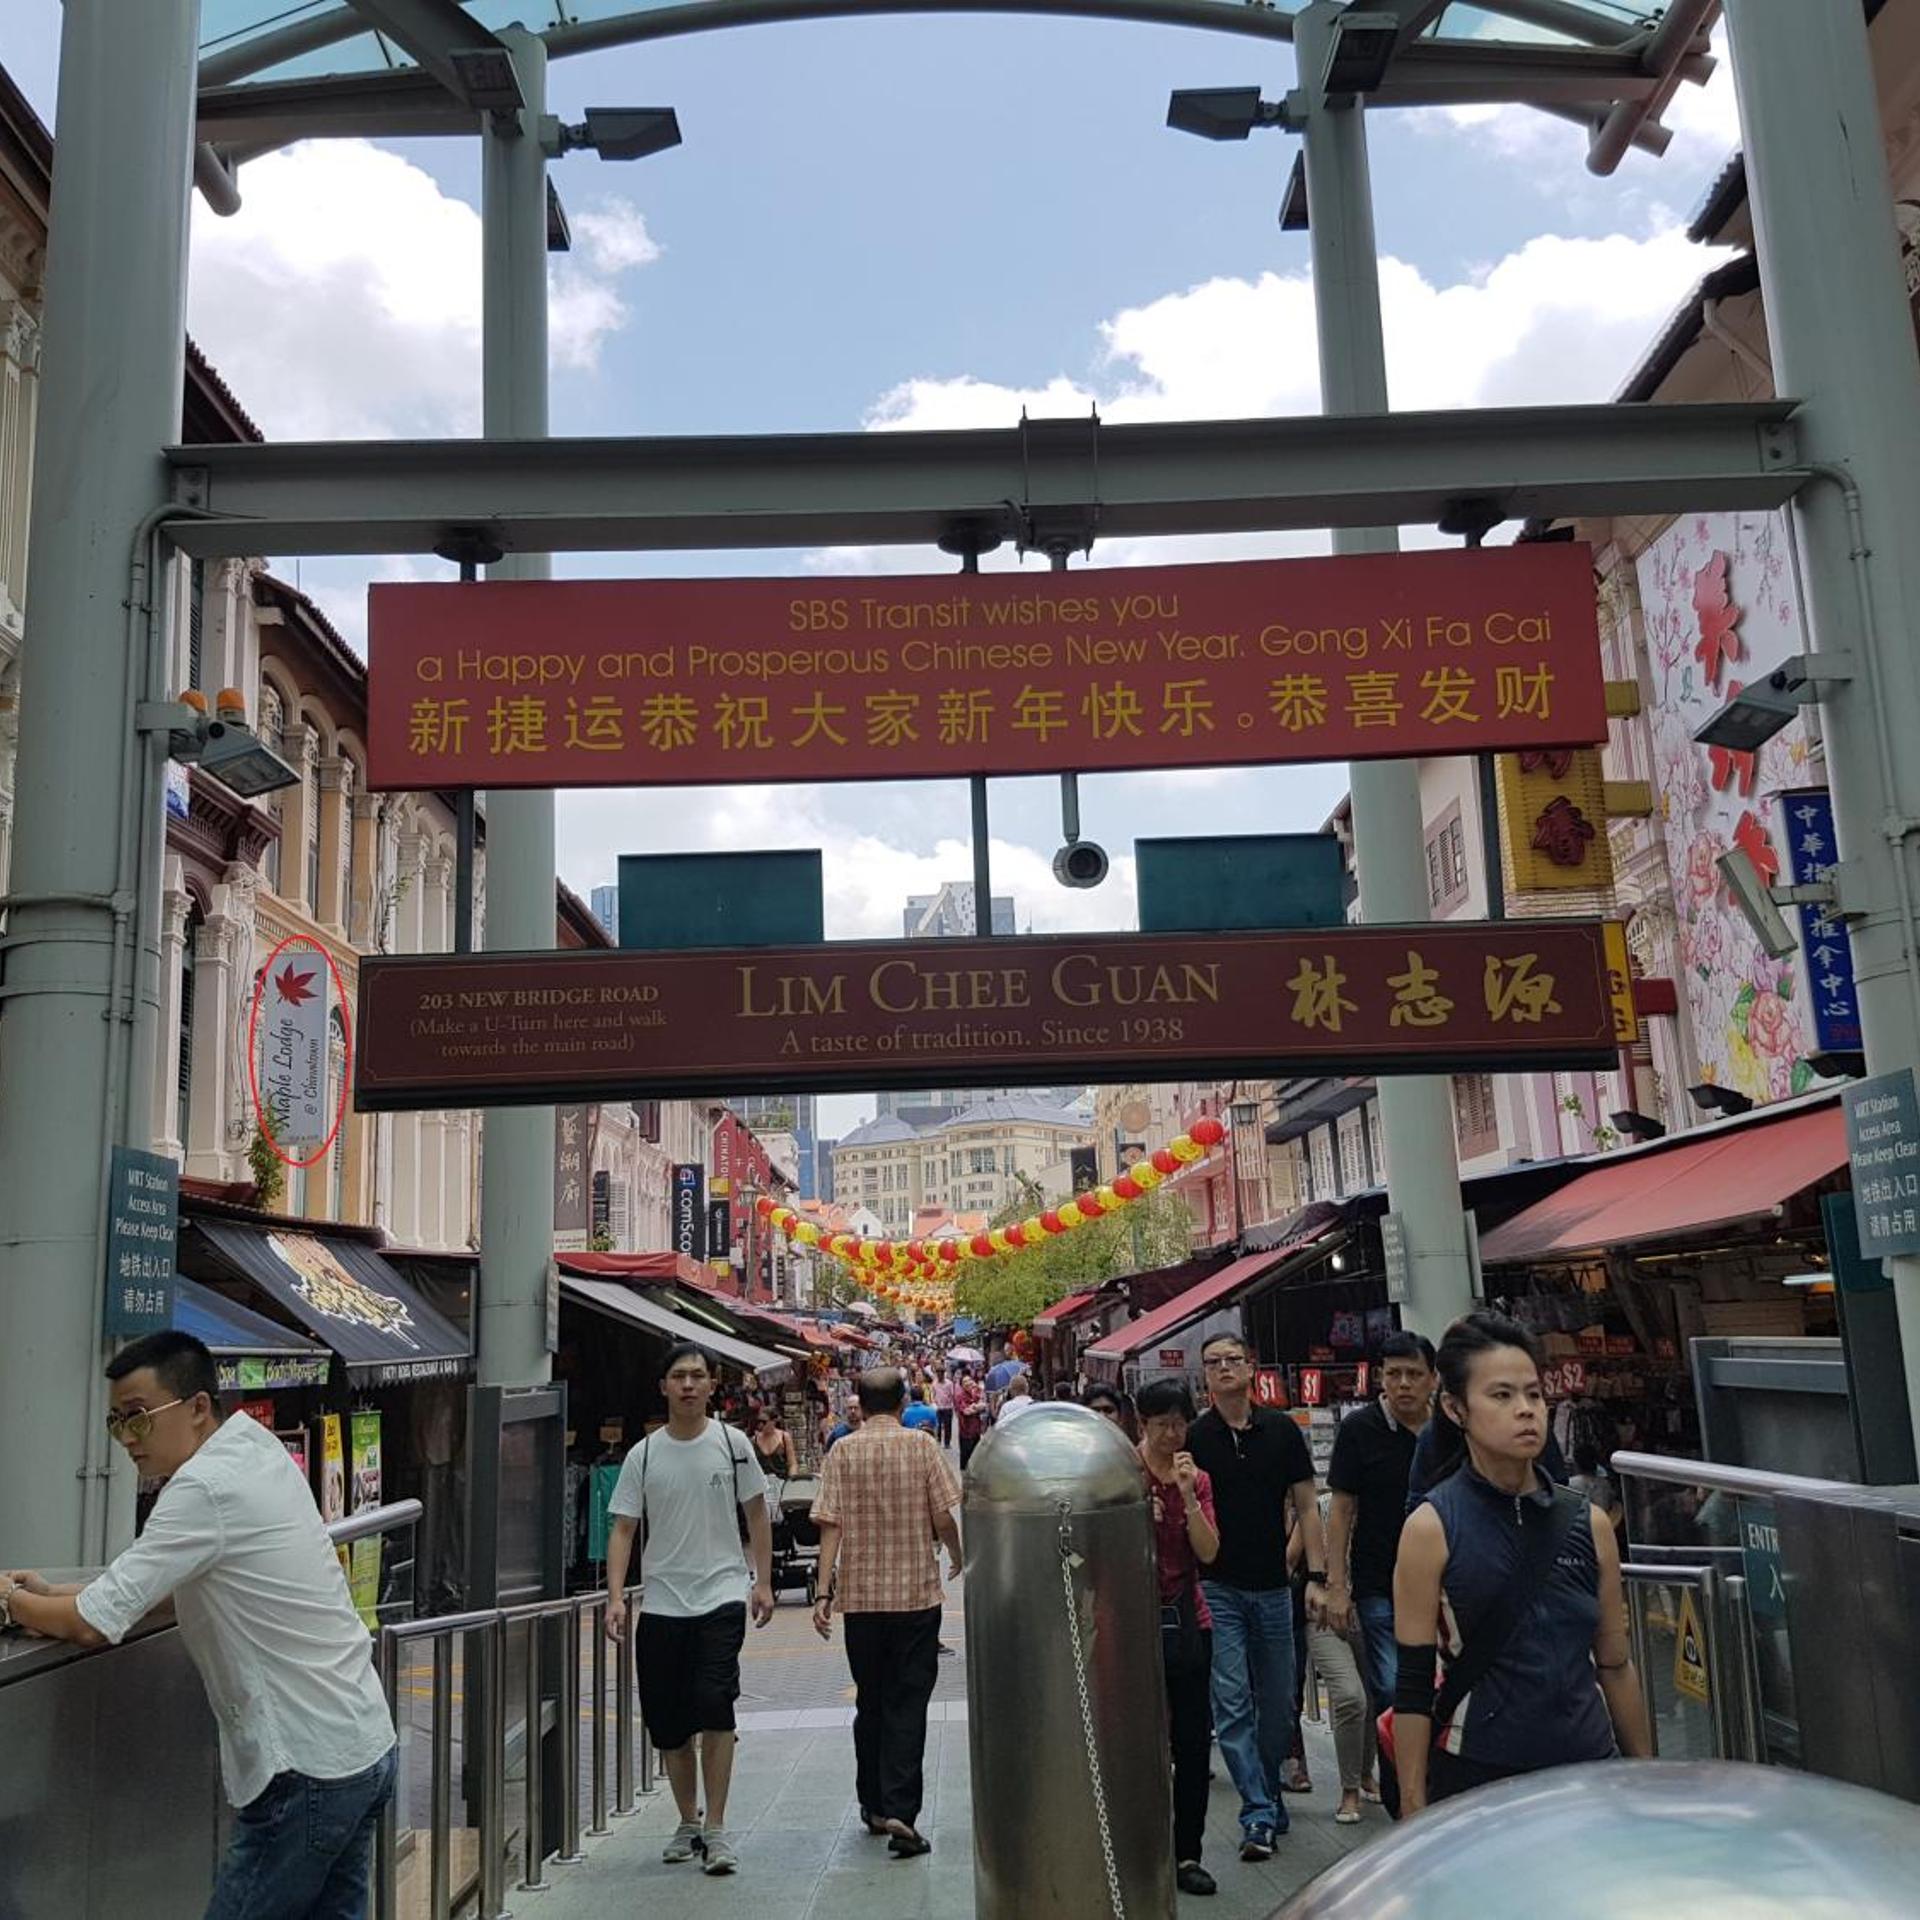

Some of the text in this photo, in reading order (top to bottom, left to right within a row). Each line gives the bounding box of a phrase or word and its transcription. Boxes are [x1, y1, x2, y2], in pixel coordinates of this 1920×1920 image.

[789, 593, 1179, 631] SBS Transit wishes you
[415, 611, 1551, 687] a Happy and Prosperous Chinese New Year. Gong Xi Fa Cai
[408, 661, 1555, 757] 新捷运恭祝大家新年快乐。恭喜发财
[418, 985, 660, 1011] 203 NEW BRIDGE ROAD
[1286, 951, 1563, 1032] 林志源
[409, 1010, 668, 1037] (Make a U-Turn here and walk
[779, 1016, 1185, 1055] A taste of tradition. Since 1938
[440, 1033, 637, 1057] towards the main road)
[268, 1018, 303, 1129] Maple Lodge
[304, 1104, 318, 1116] @
[1882, 1120, 1901, 1136] Area
[1874, 1146, 1894, 1165] Keep
[1894, 1140, 1918, 1158] Clear
[128, 1168, 168, 1192] MRT Station
[127, 1194, 168, 1216] Access Area
[115, 1216, 175, 1242] Please Keep Clear
